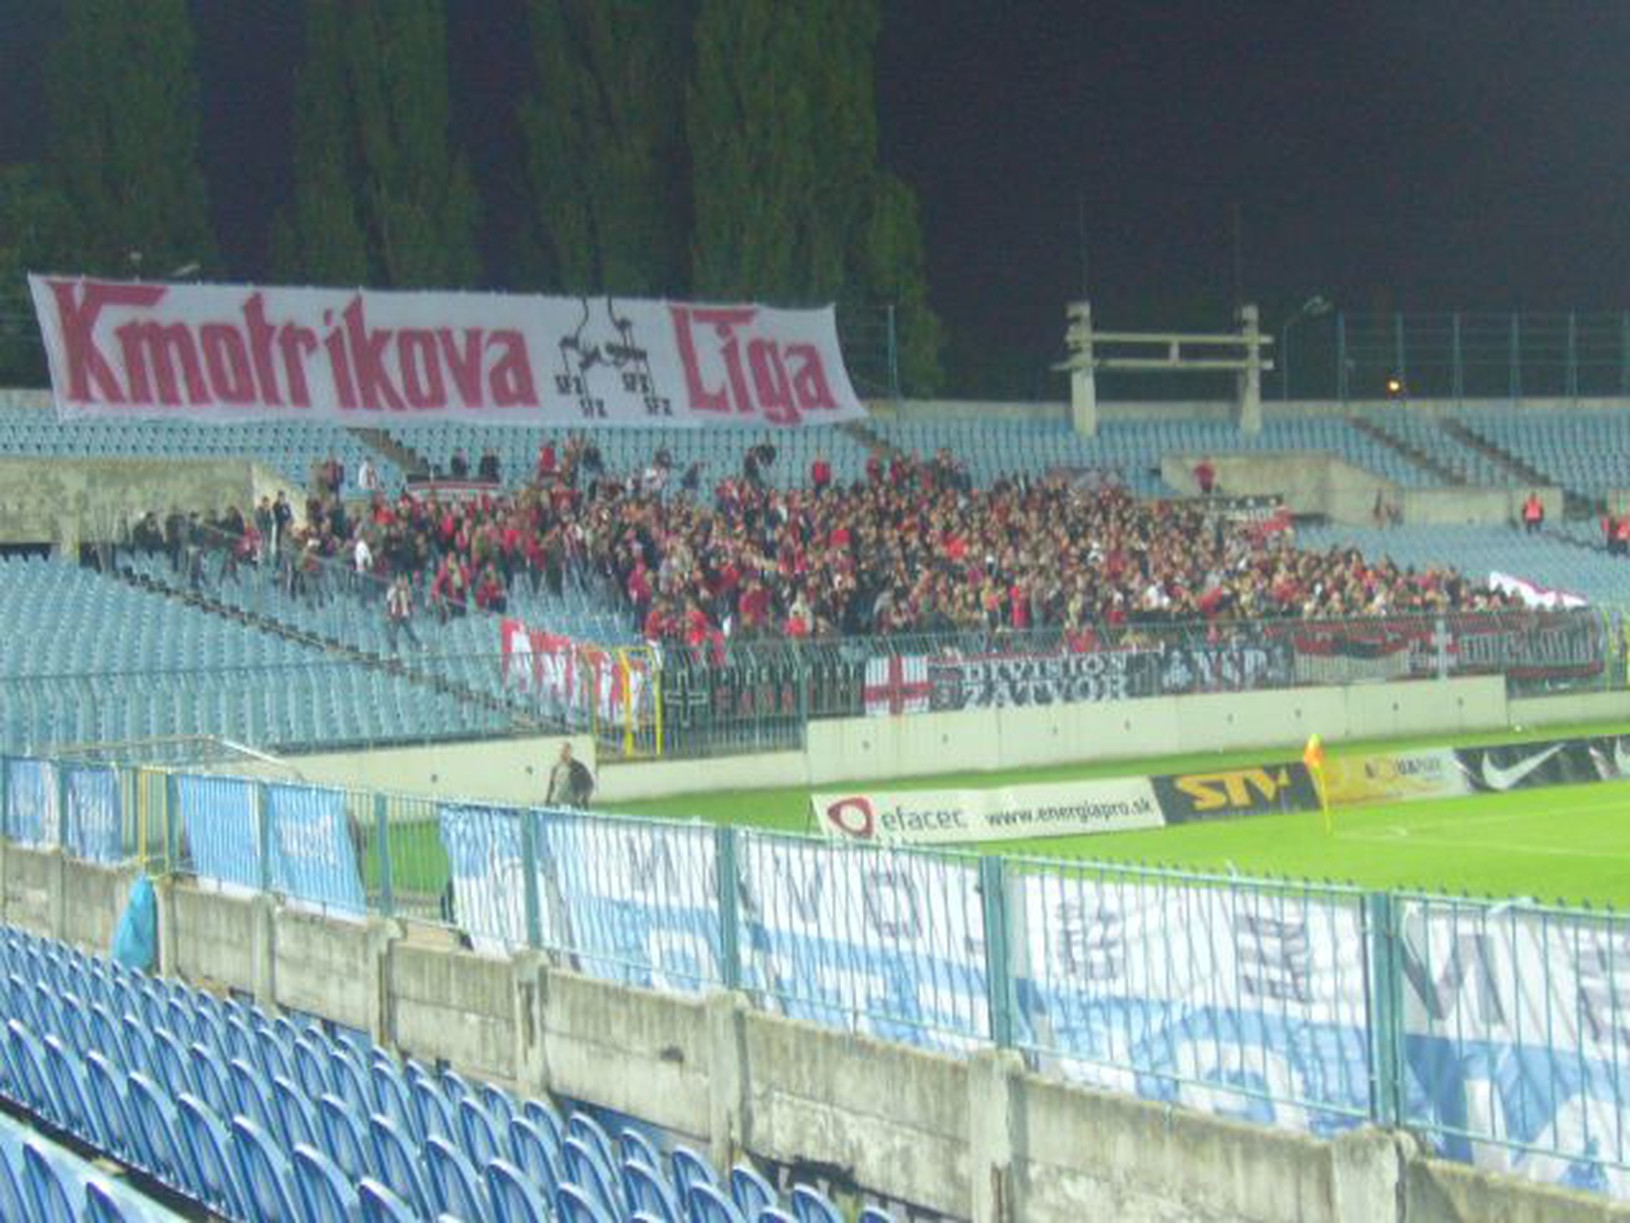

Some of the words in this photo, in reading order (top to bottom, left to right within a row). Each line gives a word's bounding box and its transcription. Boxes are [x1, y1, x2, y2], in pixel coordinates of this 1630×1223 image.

[669, 304, 839, 425] Liga
[963, 651, 1127, 683] DIVISION
[1175, 767, 1290, 811] STV
[881, 806, 967, 832] efacec
[984, 797, 1151, 826] www.energiapro.sk
